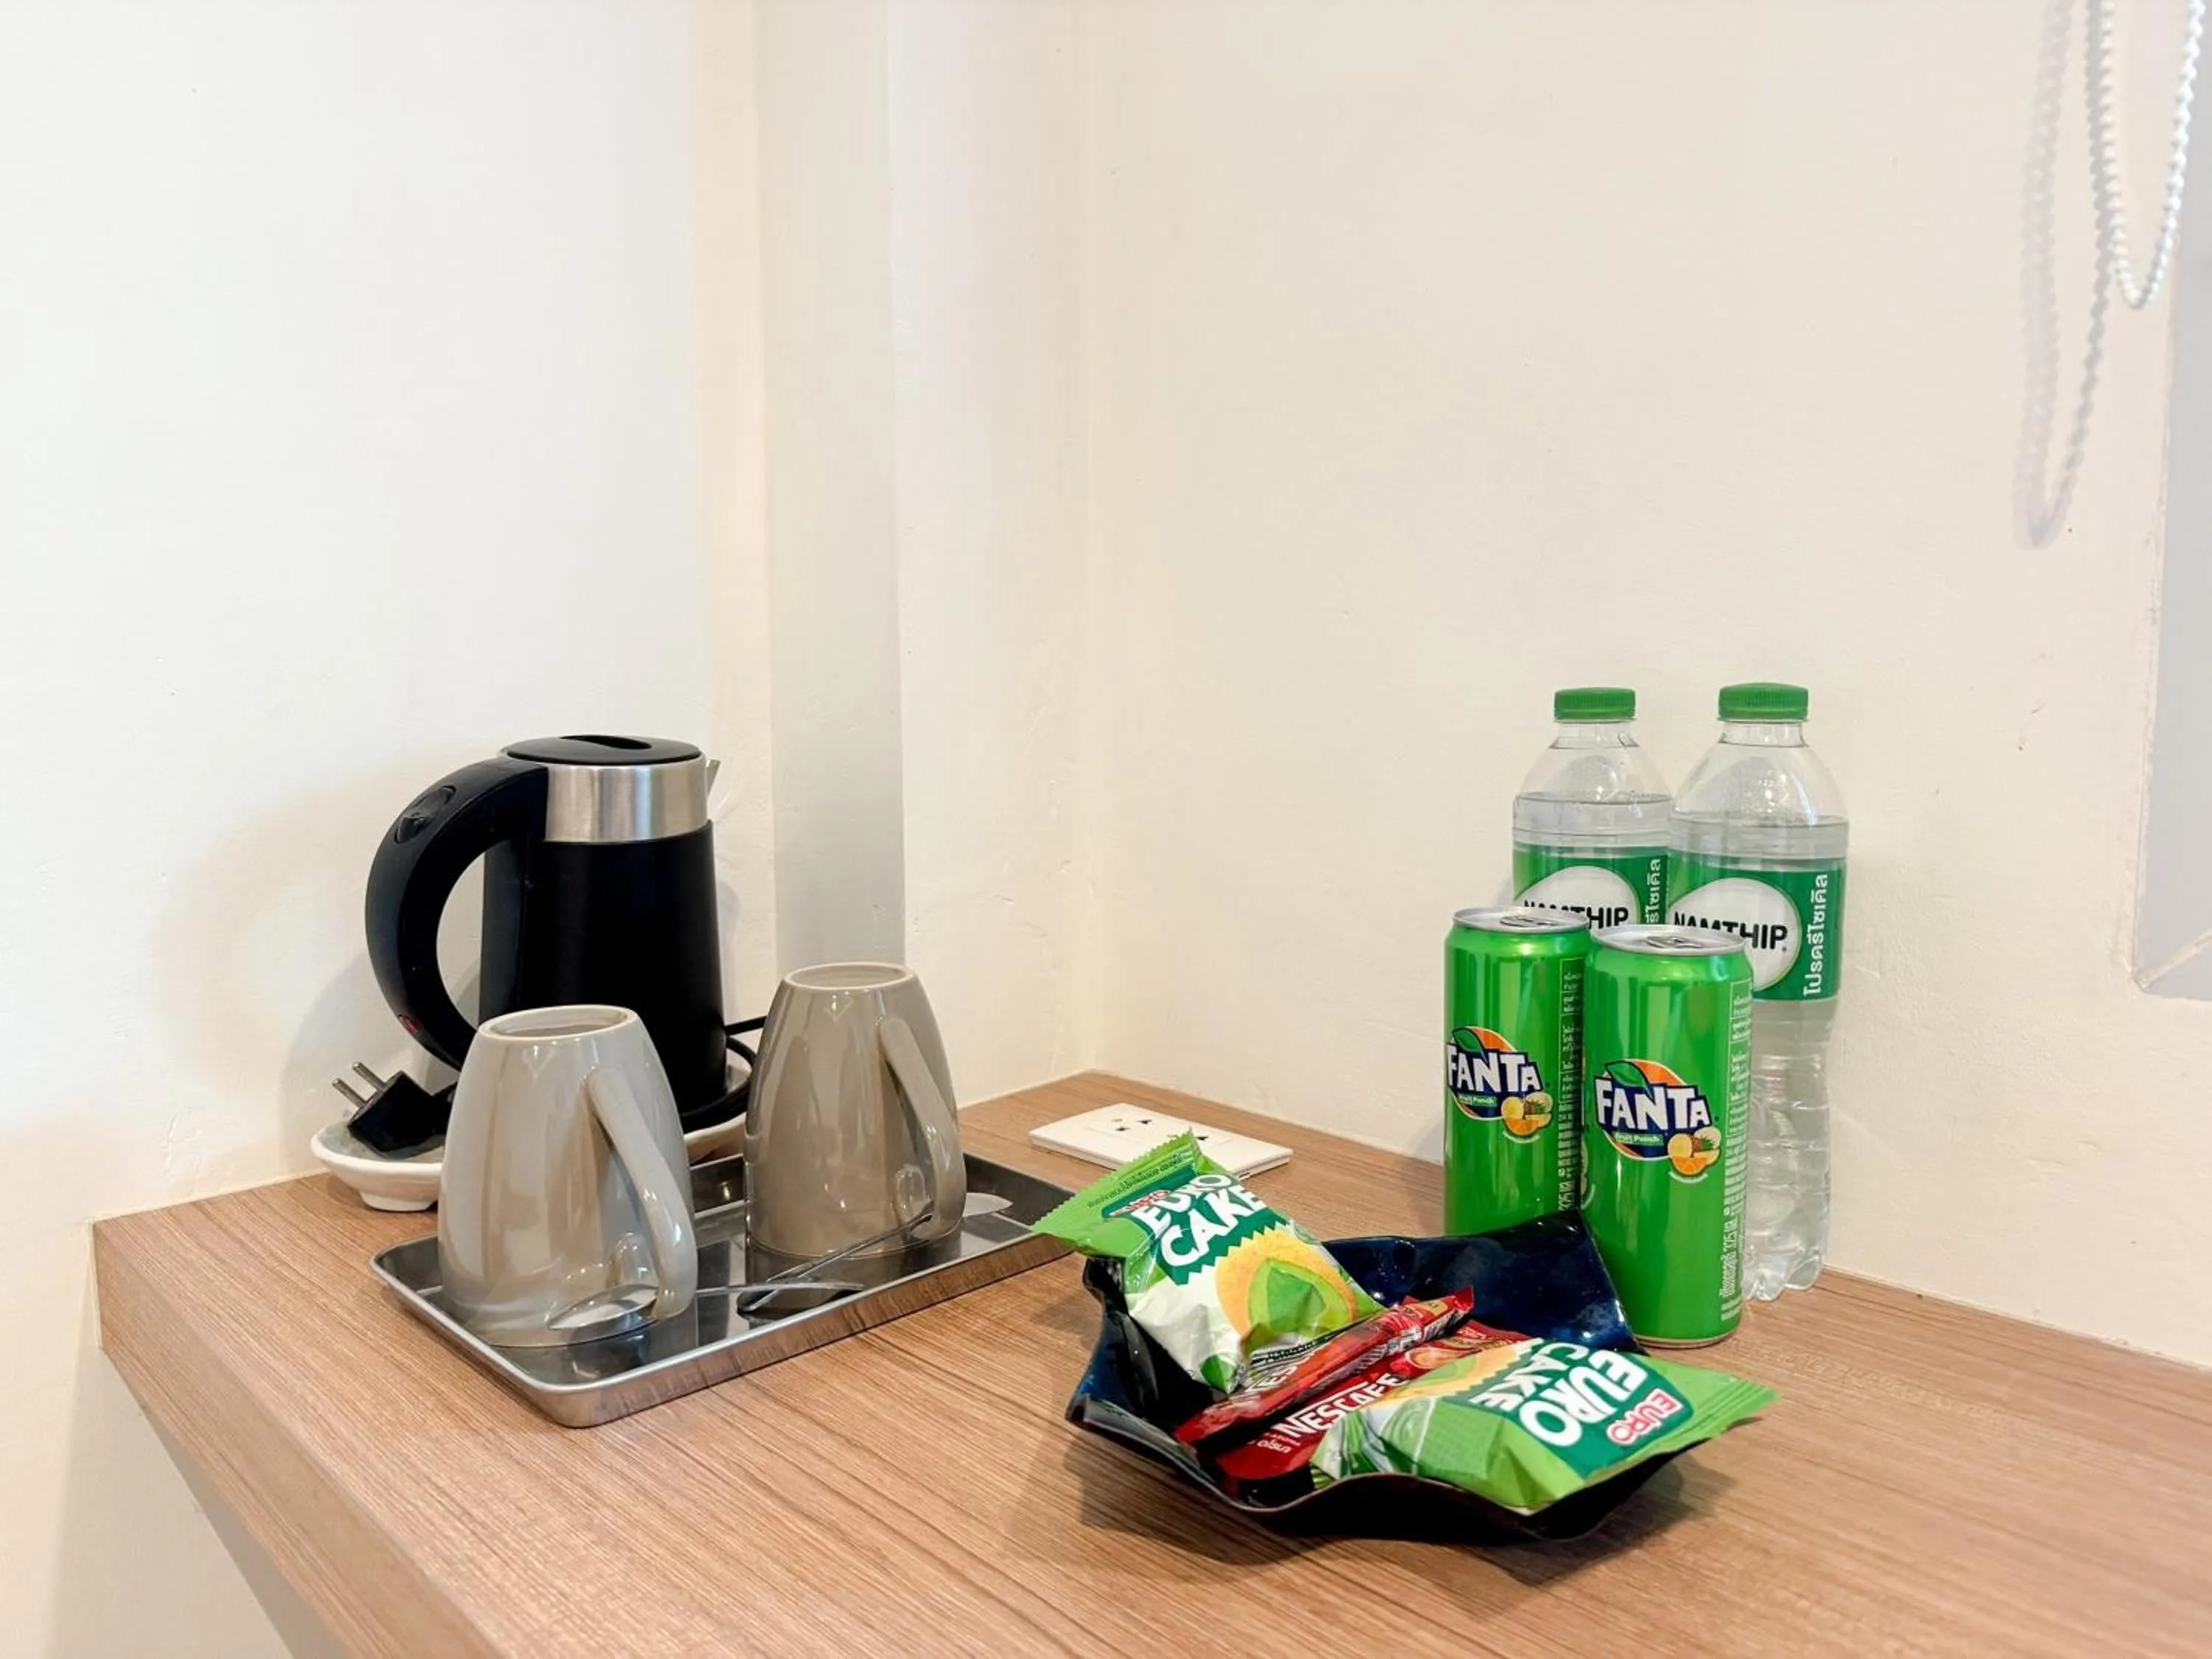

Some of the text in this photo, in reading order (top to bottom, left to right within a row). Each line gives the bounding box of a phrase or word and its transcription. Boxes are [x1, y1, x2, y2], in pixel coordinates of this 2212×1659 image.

[1804, 874, 1828, 995] โปรดรีไซเคิล
[1447, 1045, 1541, 1093] FANTA
[1596, 1079, 1711, 1130] FANTA
[1130, 1174, 1231, 1239] EURO
[1160, 1185, 1267, 1267] CAKE
[1469, 1342, 1589, 1412] CAKE
[1519, 1350, 1648, 1447] EURO
[1606, 1388, 1684, 1445] EURO
